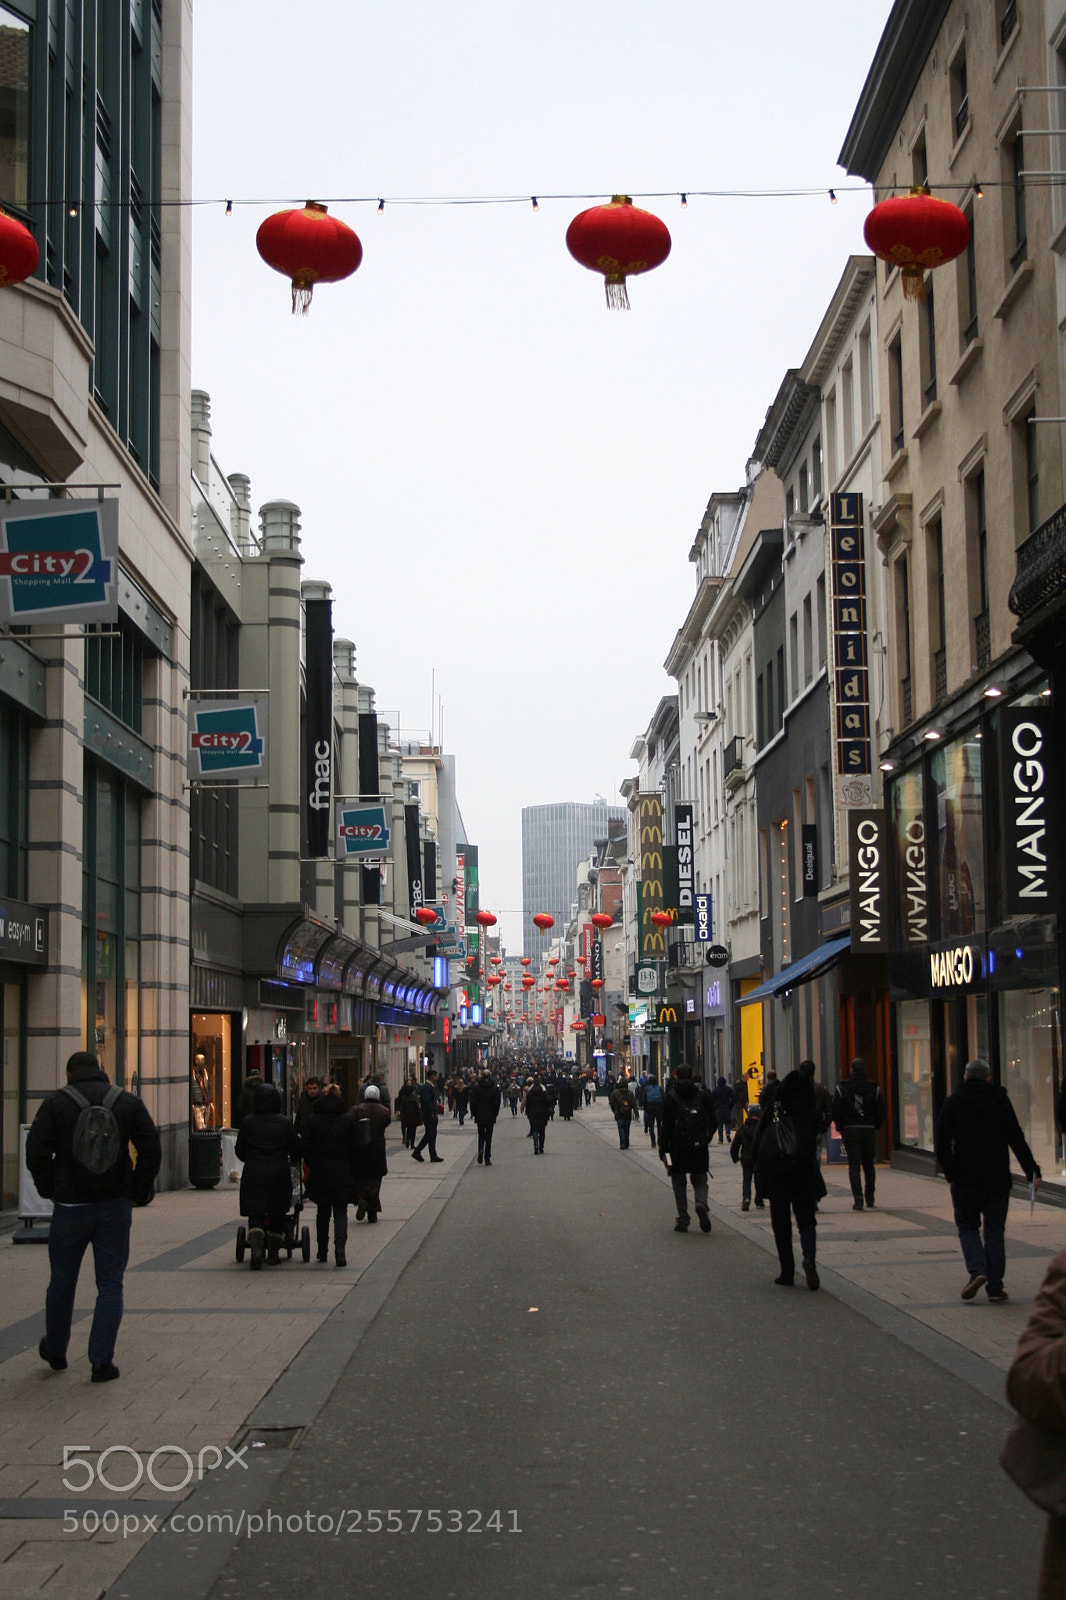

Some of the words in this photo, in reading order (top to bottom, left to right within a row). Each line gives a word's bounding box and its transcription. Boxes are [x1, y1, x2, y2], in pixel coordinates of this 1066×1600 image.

[11, 548, 96, 584] City2
[14, 578, 51, 586] Shopping
[53, 577, 71, 585] Mall
[839, 497, 862, 767] Leonidas
[200, 731, 253, 754] City2
[309, 740, 330, 810] fnac
[1011, 721, 1048, 898] MANGO
[345, 824, 383, 841] City2
[677, 815, 693, 907] DIESEL
[805, 843, 814, 881] Desigual
[857, 820, 881, 942] MANGO
[696, 896, 708, 939] okaïdi
[930, 945, 973, 988] MANGO
